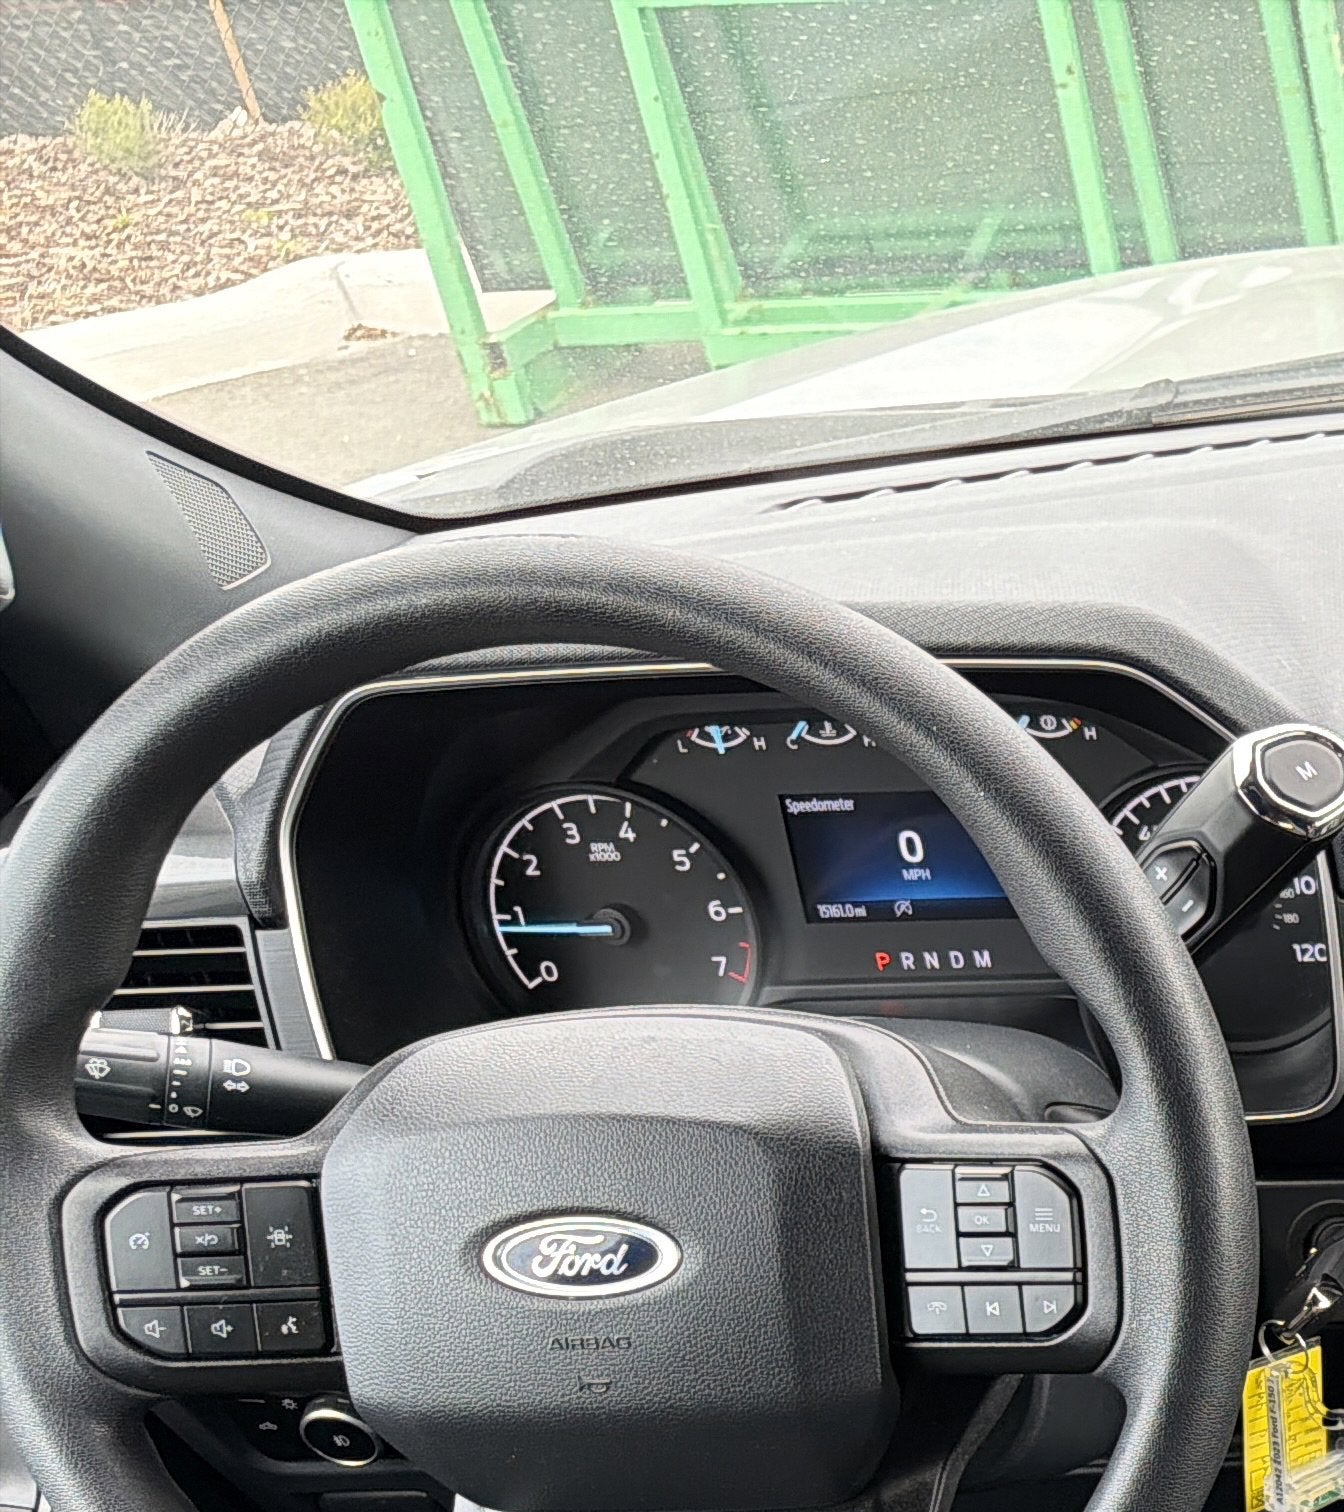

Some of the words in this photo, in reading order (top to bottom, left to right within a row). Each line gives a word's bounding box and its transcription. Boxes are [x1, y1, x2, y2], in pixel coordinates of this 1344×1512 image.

[1083, 726, 1096, 740] H
[677, 739, 688, 753] L
[753, 737, 766, 750] H
[1295, 760, 1318, 781] M
[785, 798, 855, 816] Speedometer
[561, 822, 581, 844] 3
[618, 820, 637, 842] 4
[590, 841, 615, 853] RPM
[898, 829, 924, 864] 0
[589, 850, 622, 863] x1000
[671, 849, 692, 871] 5
[523, 855, 541, 876] 2
[902, 868, 931, 881] MPH
[707, 900, 727, 922] 6
[854, 904, 867, 917] mi
[1282, 912, 1300, 923] 180
[711, 955, 727, 977] 7
[874, 951, 891, 971] P
[900, 951, 916, 970] R
[922, 950, 940, 970] N
[950, 950, 965, 969] D
[972, 949, 992, 969] M
[540, 960, 558, 981] 0
[974, 1215, 989, 1225] OK
[1029, 1223, 1061, 1233] MENU
[916, 1224, 942, 1233] BACK
[531, 1234, 629, 1278] Ford
[550, 1336, 632, 1351] AIRBAG
